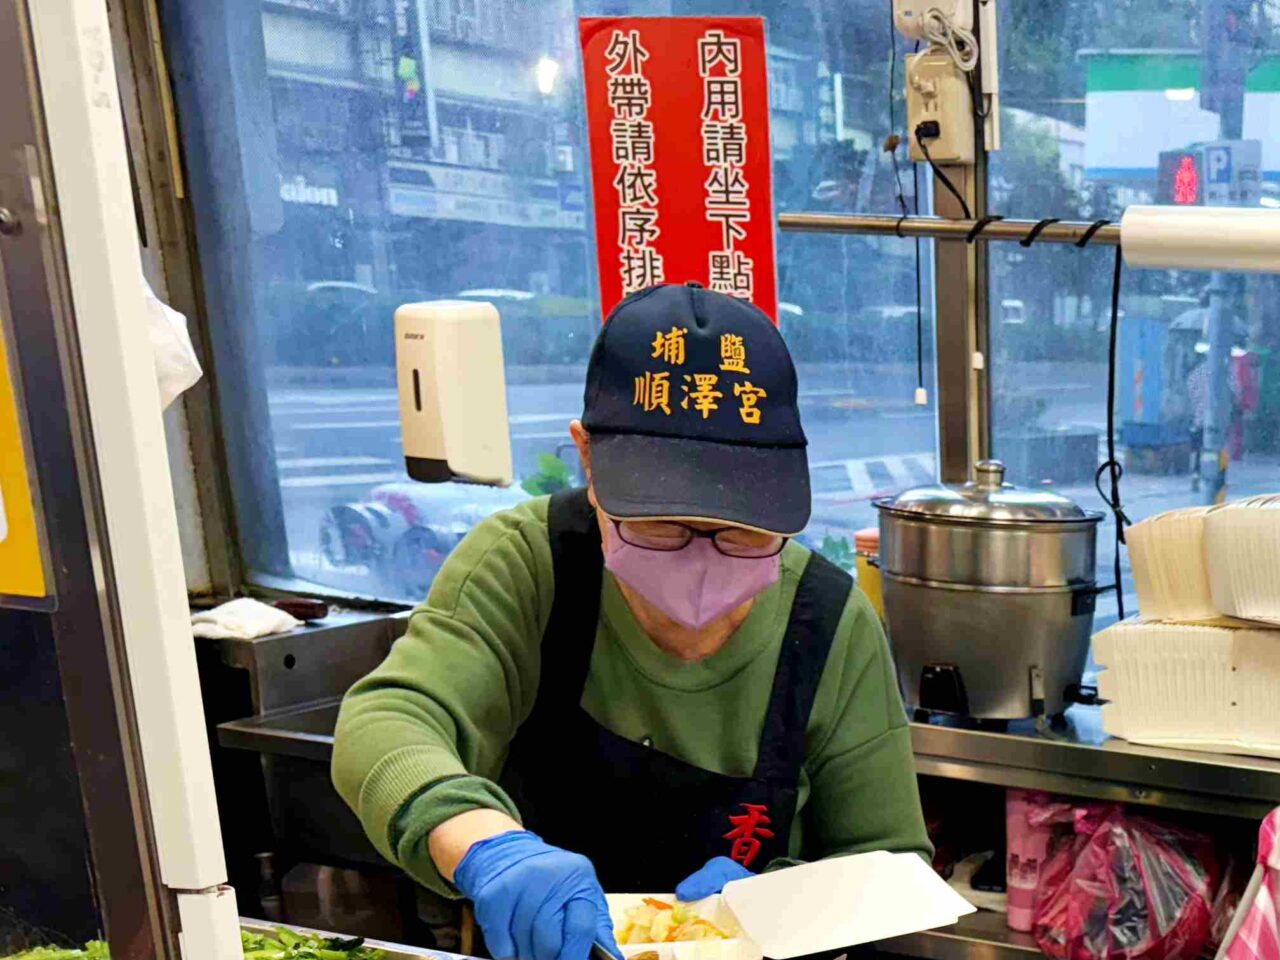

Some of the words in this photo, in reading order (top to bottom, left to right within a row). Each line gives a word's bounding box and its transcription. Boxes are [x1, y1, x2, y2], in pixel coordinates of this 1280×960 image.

[605, 30, 665, 298] 外帶請依序排
[698, 31, 754, 302] 內用請坐下點
[651, 326, 751, 375] 埔鹽
[633, 371, 767, 424] 順澤宮
[723, 802, 775, 868] 香
